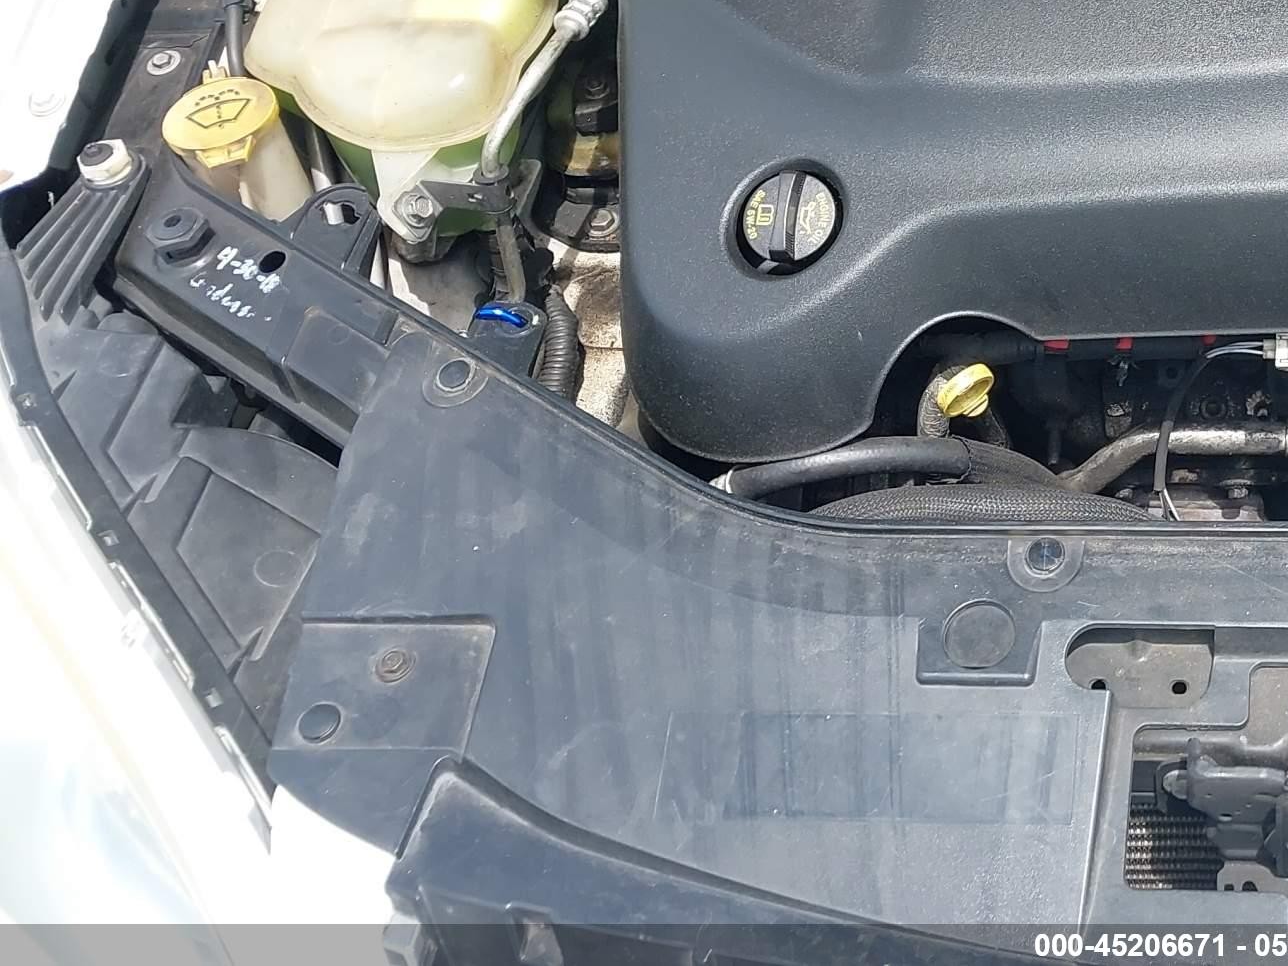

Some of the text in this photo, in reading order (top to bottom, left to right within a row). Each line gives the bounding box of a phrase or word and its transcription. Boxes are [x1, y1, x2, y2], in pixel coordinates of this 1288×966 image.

[750, 189, 766, 209] SAE
[807, 192, 832, 245] ENGINE OIL
